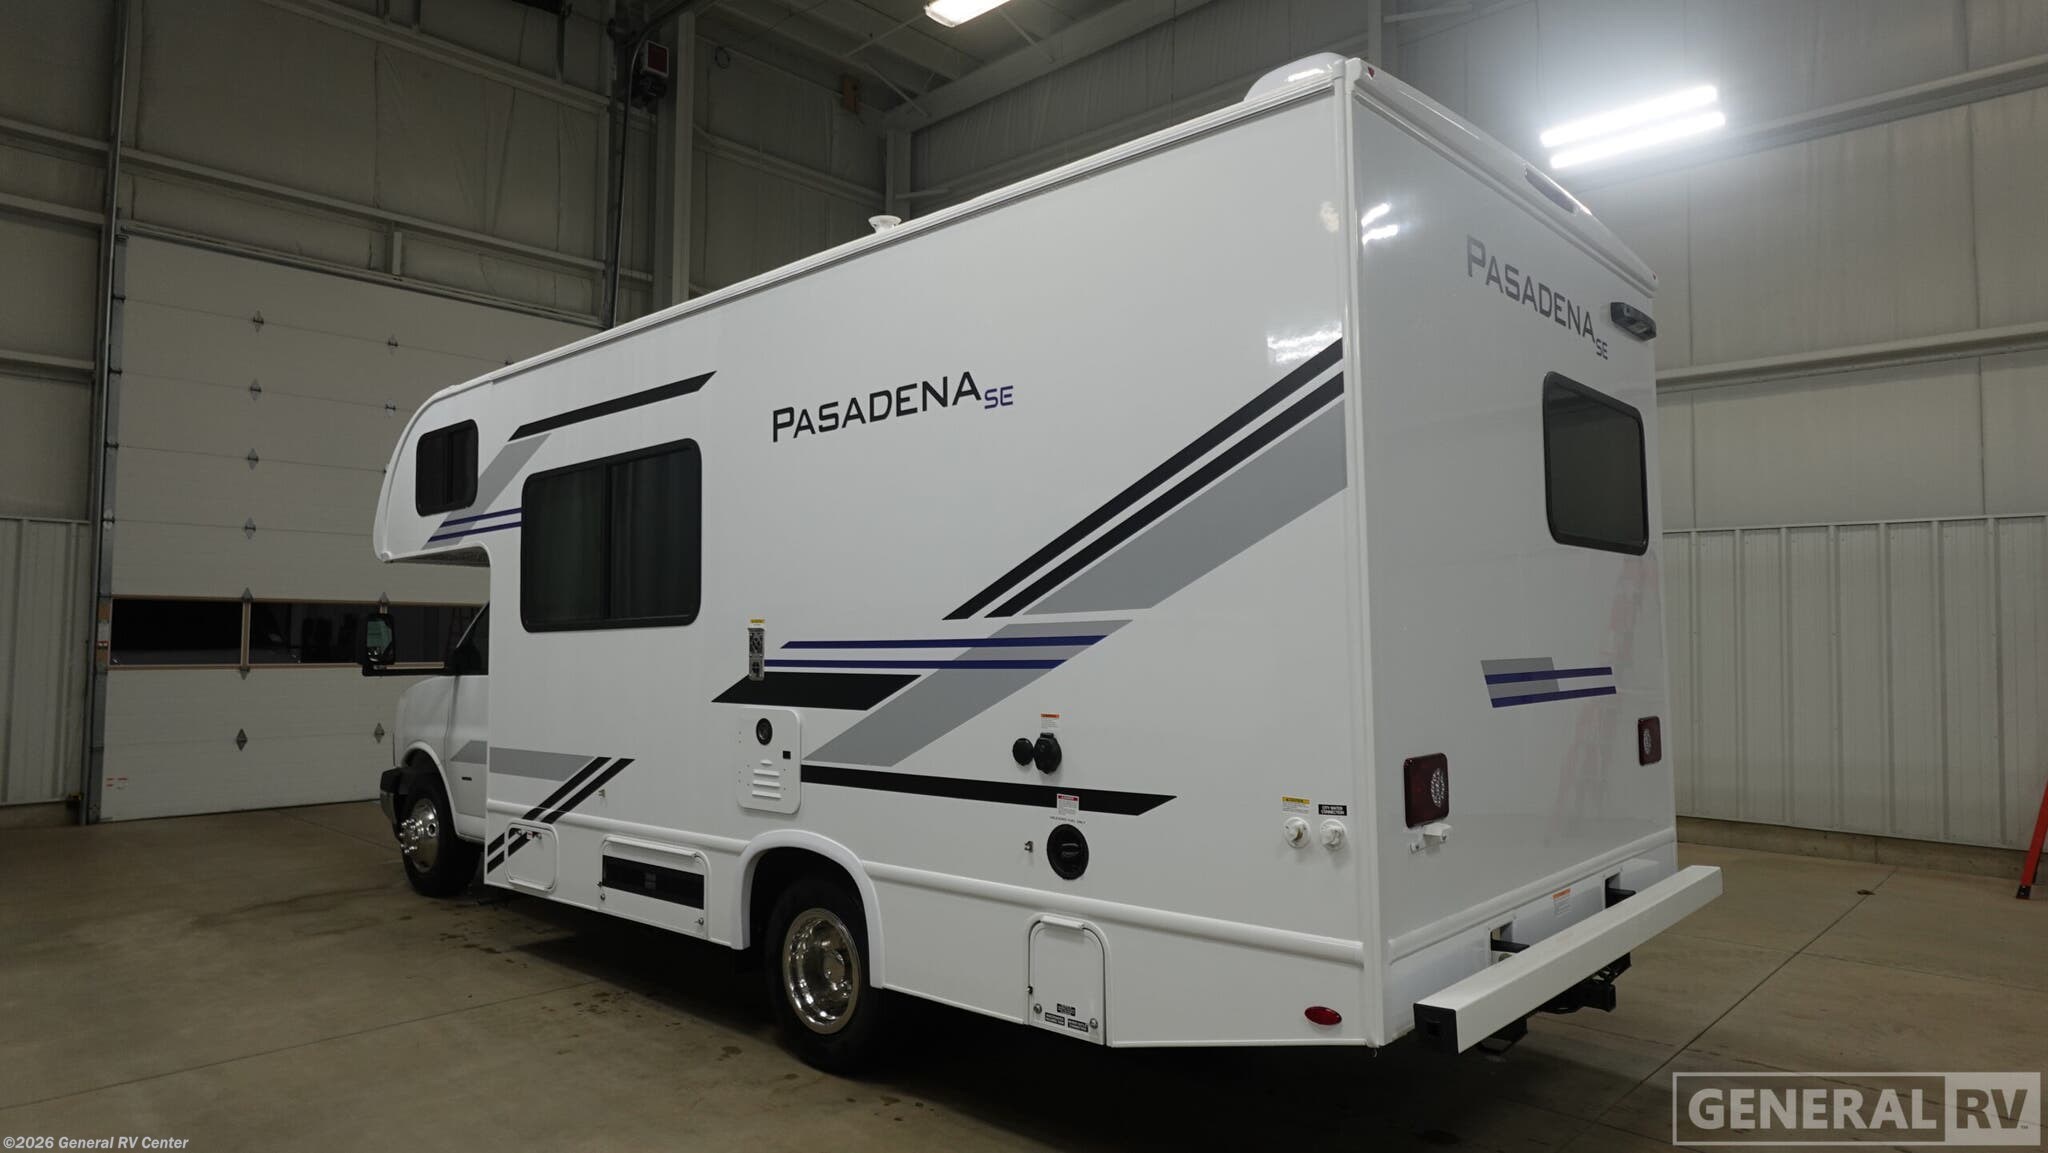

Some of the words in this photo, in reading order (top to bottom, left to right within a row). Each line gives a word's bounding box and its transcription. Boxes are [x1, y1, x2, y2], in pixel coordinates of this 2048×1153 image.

[1467, 235, 1596, 344] PASADENA
[1595, 338, 1608, 361] SE
[772, 371, 982, 443] PASADENA
[983, 385, 1014, 410] SE
